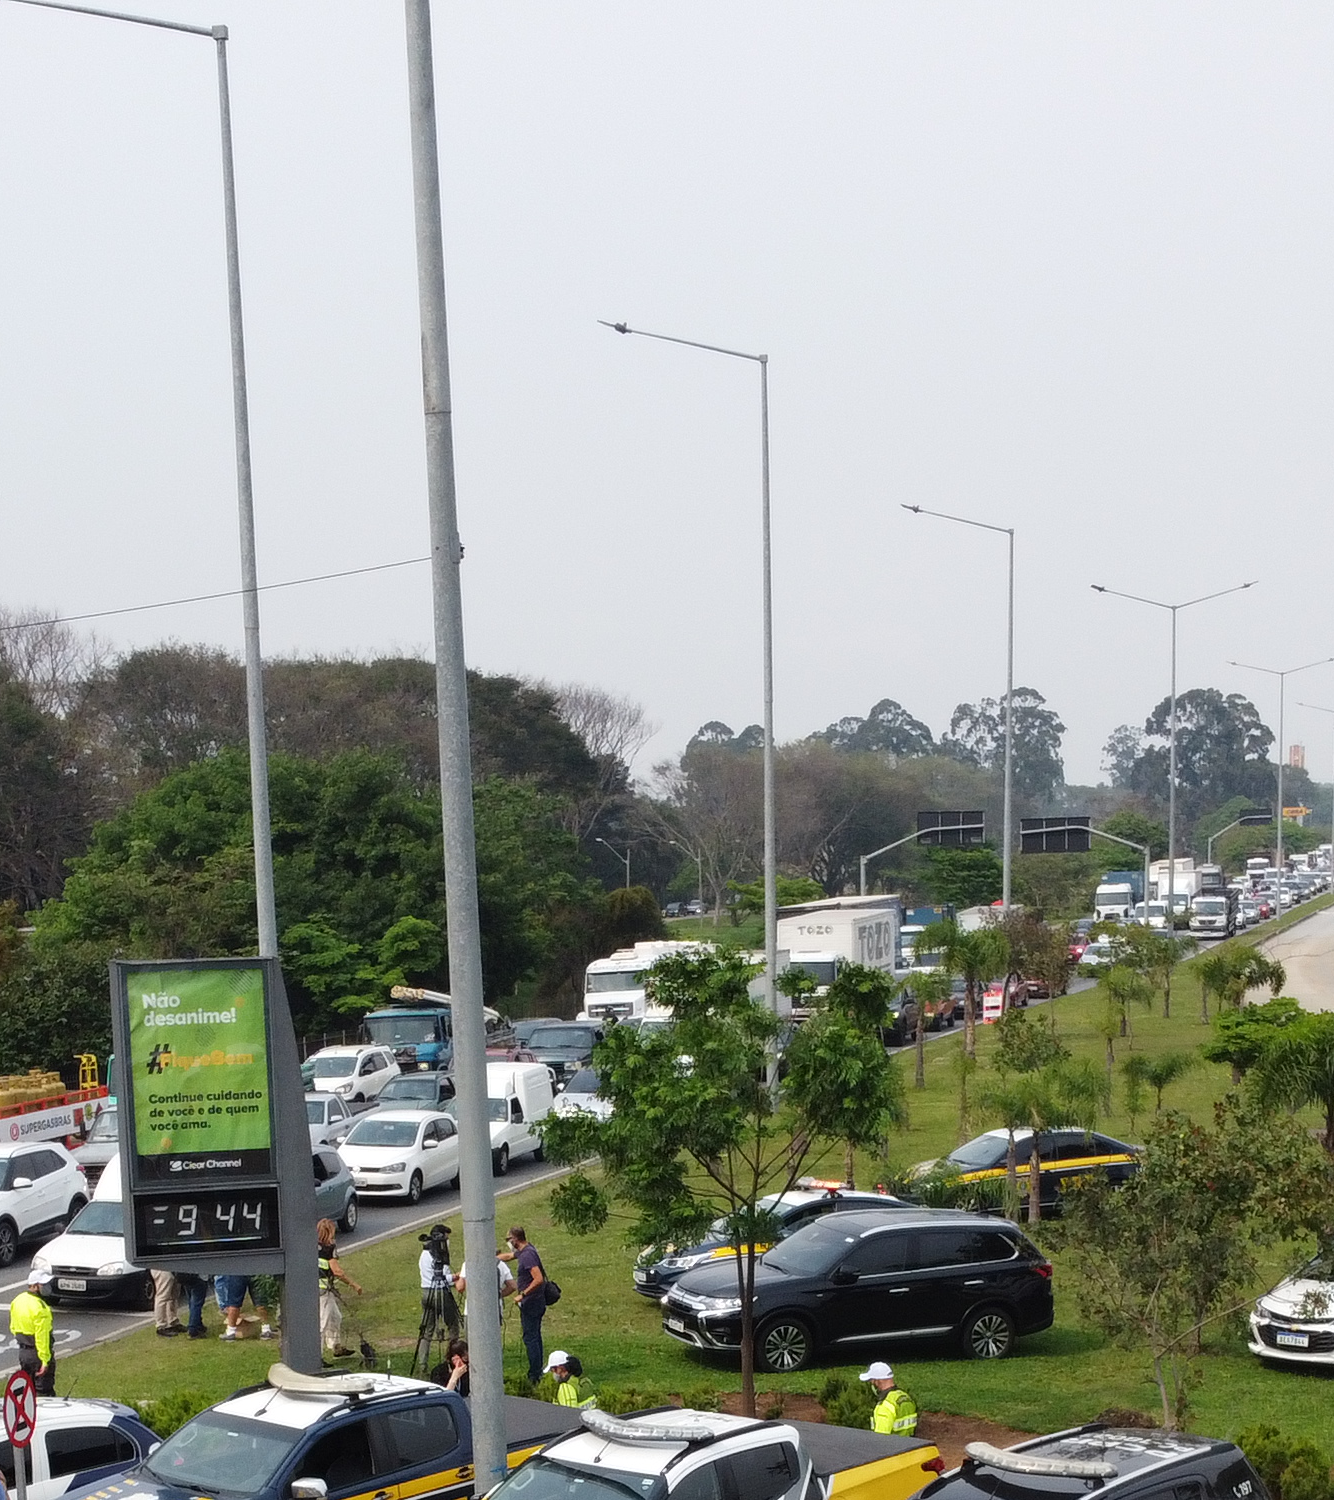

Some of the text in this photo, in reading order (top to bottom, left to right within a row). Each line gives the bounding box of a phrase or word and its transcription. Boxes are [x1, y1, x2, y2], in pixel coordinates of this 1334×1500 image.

[797, 925, 834, 935] TOZO
[858, 920, 890, 962] TOZO
[142, 992, 180, 1009] Não
[144, 1007, 237, 1027] desanime!
[148, 1089, 262, 1104] Continue cuidando
[149, 1104, 259, 1118] de você e de quem
[20, 1114, 72, 1135] SUPERGASBRAS
[150, 1120, 211, 1131] você ama.
[183, 1158, 242, 1170] Clear Channel
[1238, 1480, 1253, 1496] 197
